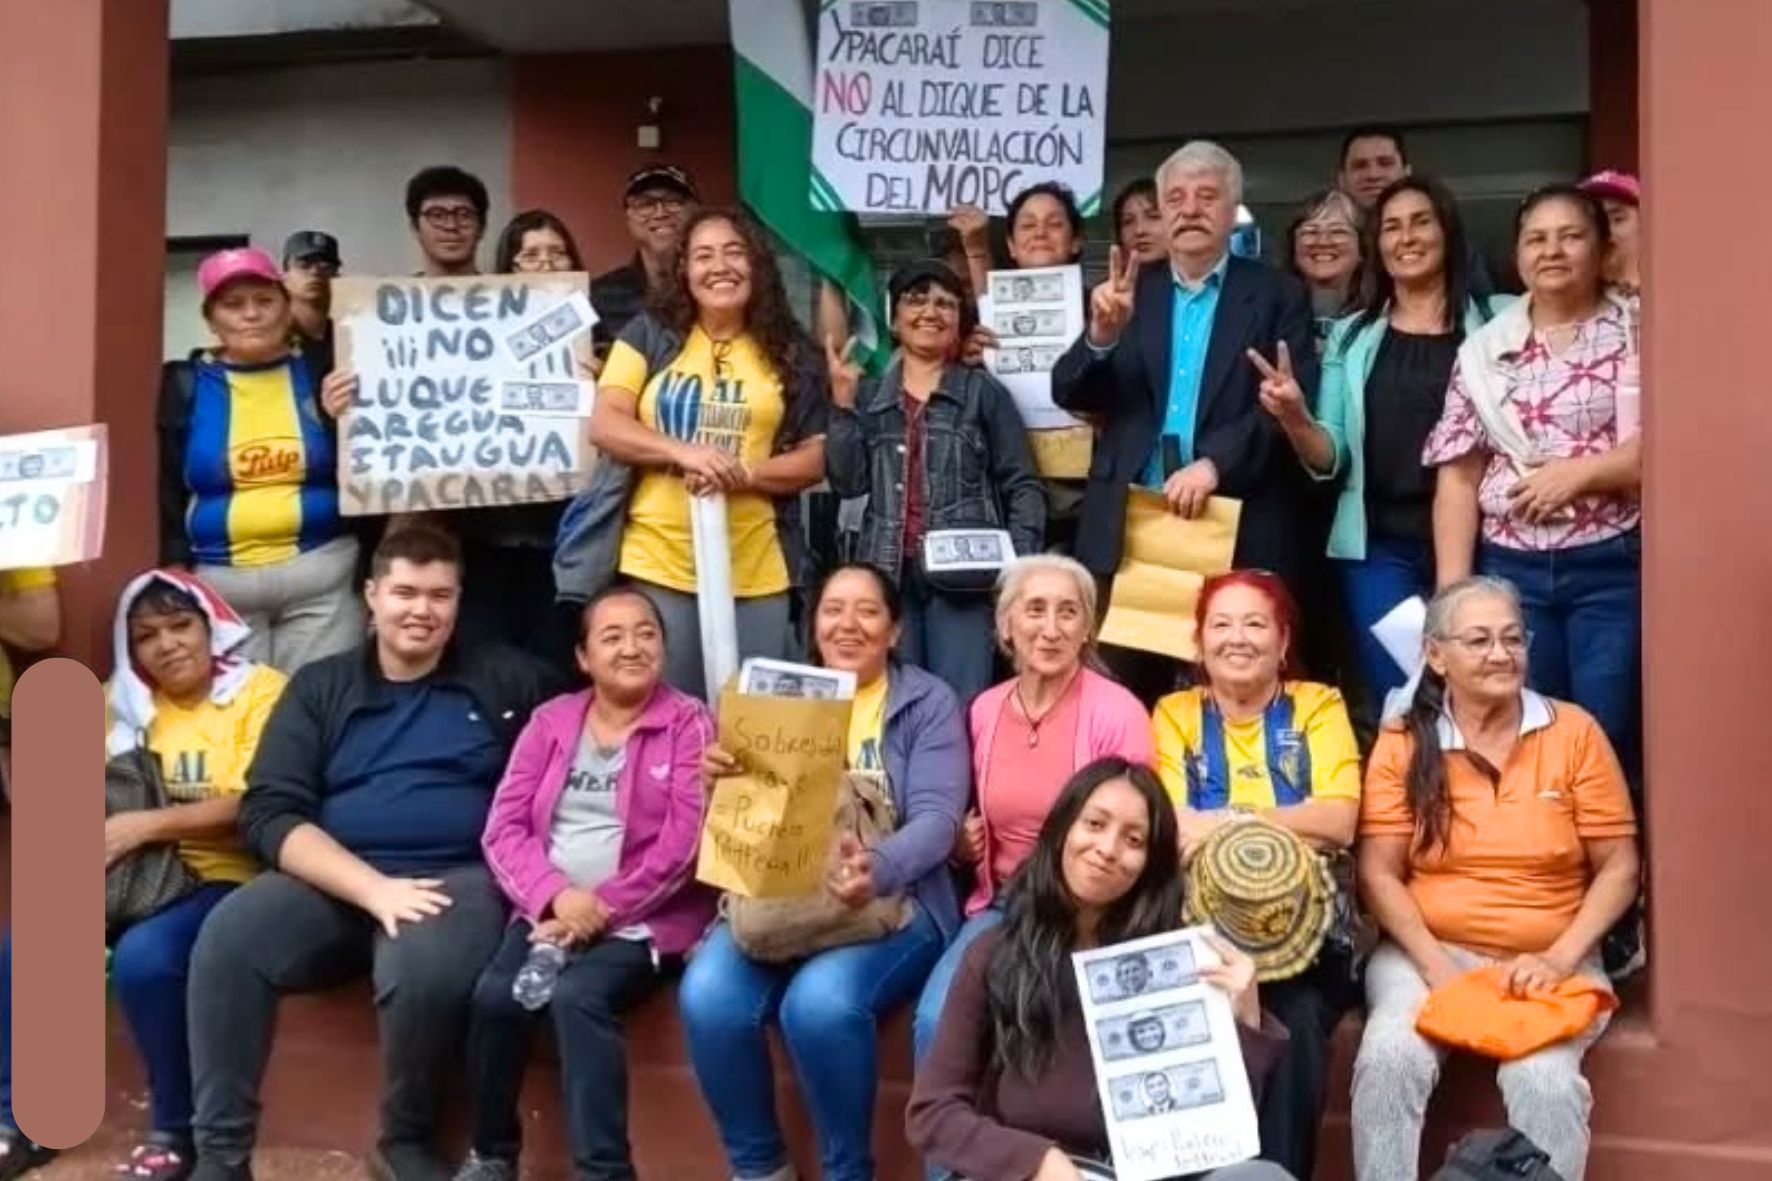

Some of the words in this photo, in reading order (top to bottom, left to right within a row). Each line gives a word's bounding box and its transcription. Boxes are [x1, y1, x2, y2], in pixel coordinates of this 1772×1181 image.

[829, 9, 961, 69] YPACARAÍ
[982, 34, 1045, 69] DICE
[822, 70, 872, 115] NO
[880, 80, 913, 118] AL
[918, 81, 1003, 119] DIQUE
[1017, 83, 1055, 116] DE
[1061, 83, 1095, 118] LA
[835, 121, 1084, 168] CIRCUNVALACIÓN
[866, 173, 920, 210] DEL
[376, 283, 528, 326] DICEN
[353, 374, 492, 409] LUQUE
[347, 409, 526, 442] AREGUA
[350, 431, 573, 474] ITAUGUA
[0, 493, 60, 528] TO
